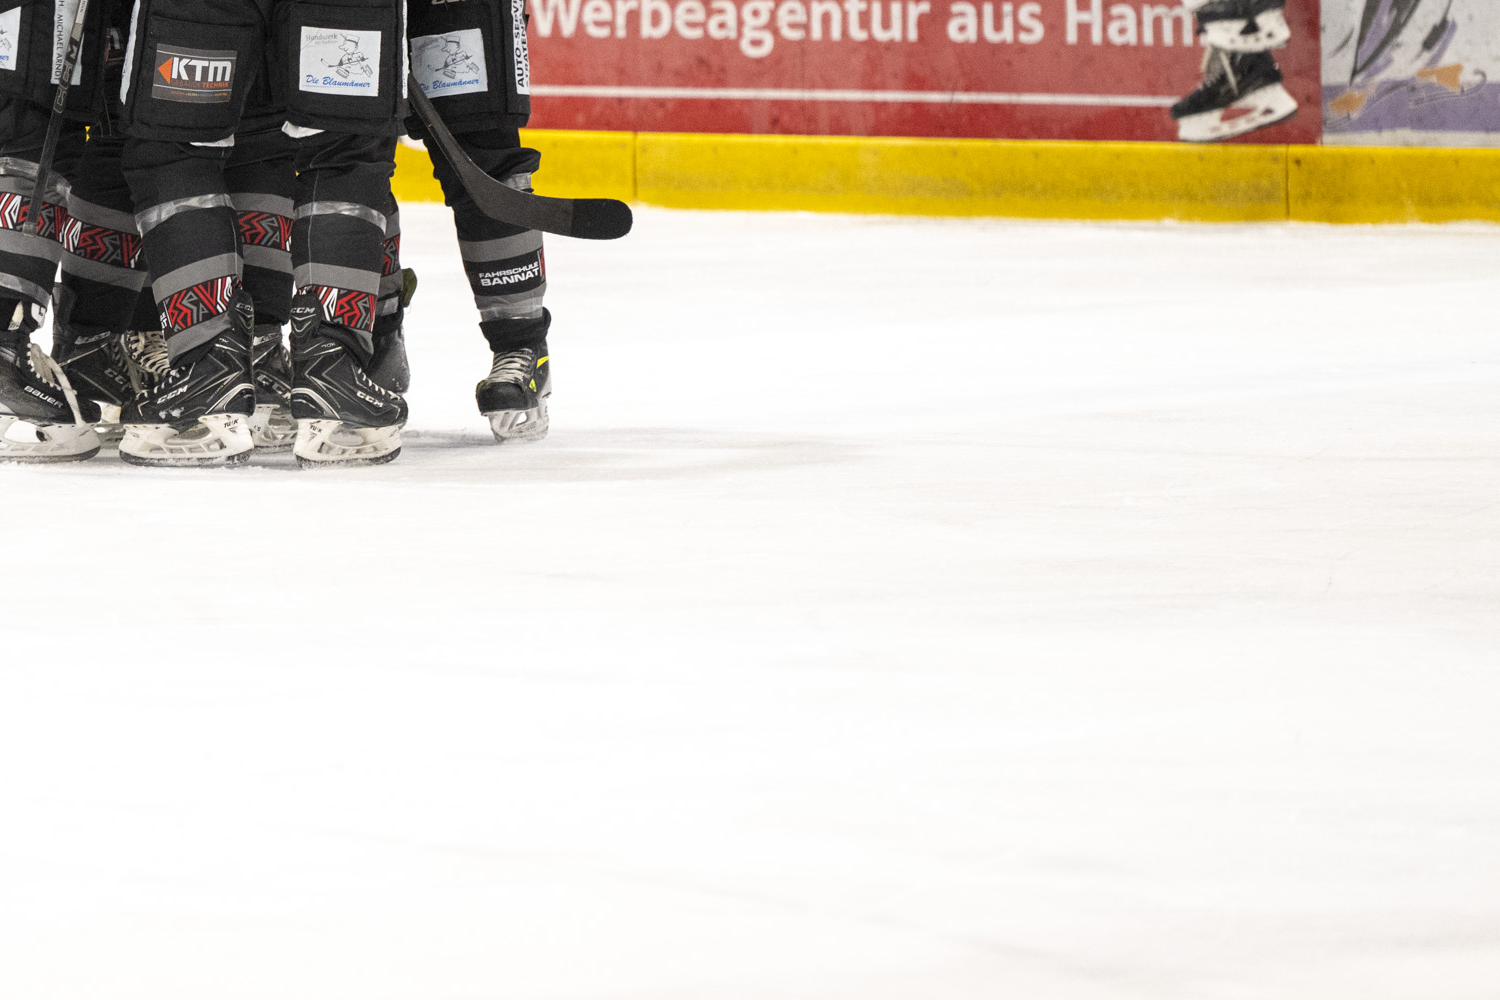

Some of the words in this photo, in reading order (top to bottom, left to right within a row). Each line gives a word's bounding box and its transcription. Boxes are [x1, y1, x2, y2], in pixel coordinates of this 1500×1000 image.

[56, 14, 64, 50] MICHAEL
[947, 1, 1046, 44] aus
[305, 33, 338, 42] Handwerk
[171, 56, 232, 82] KTM
[306, 74, 320, 85] Die
[322, 76, 371, 88] Blaumänner
[432, 79, 480, 90] Blaumänner
[479, 261, 539, 279] FAHRSCHULE
[480, 267, 540, 287] BANNAT
[24, 385, 64, 409] BAUER
[156, 385, 189, 404] CCM
[356, 390, 384, 408] CCM
